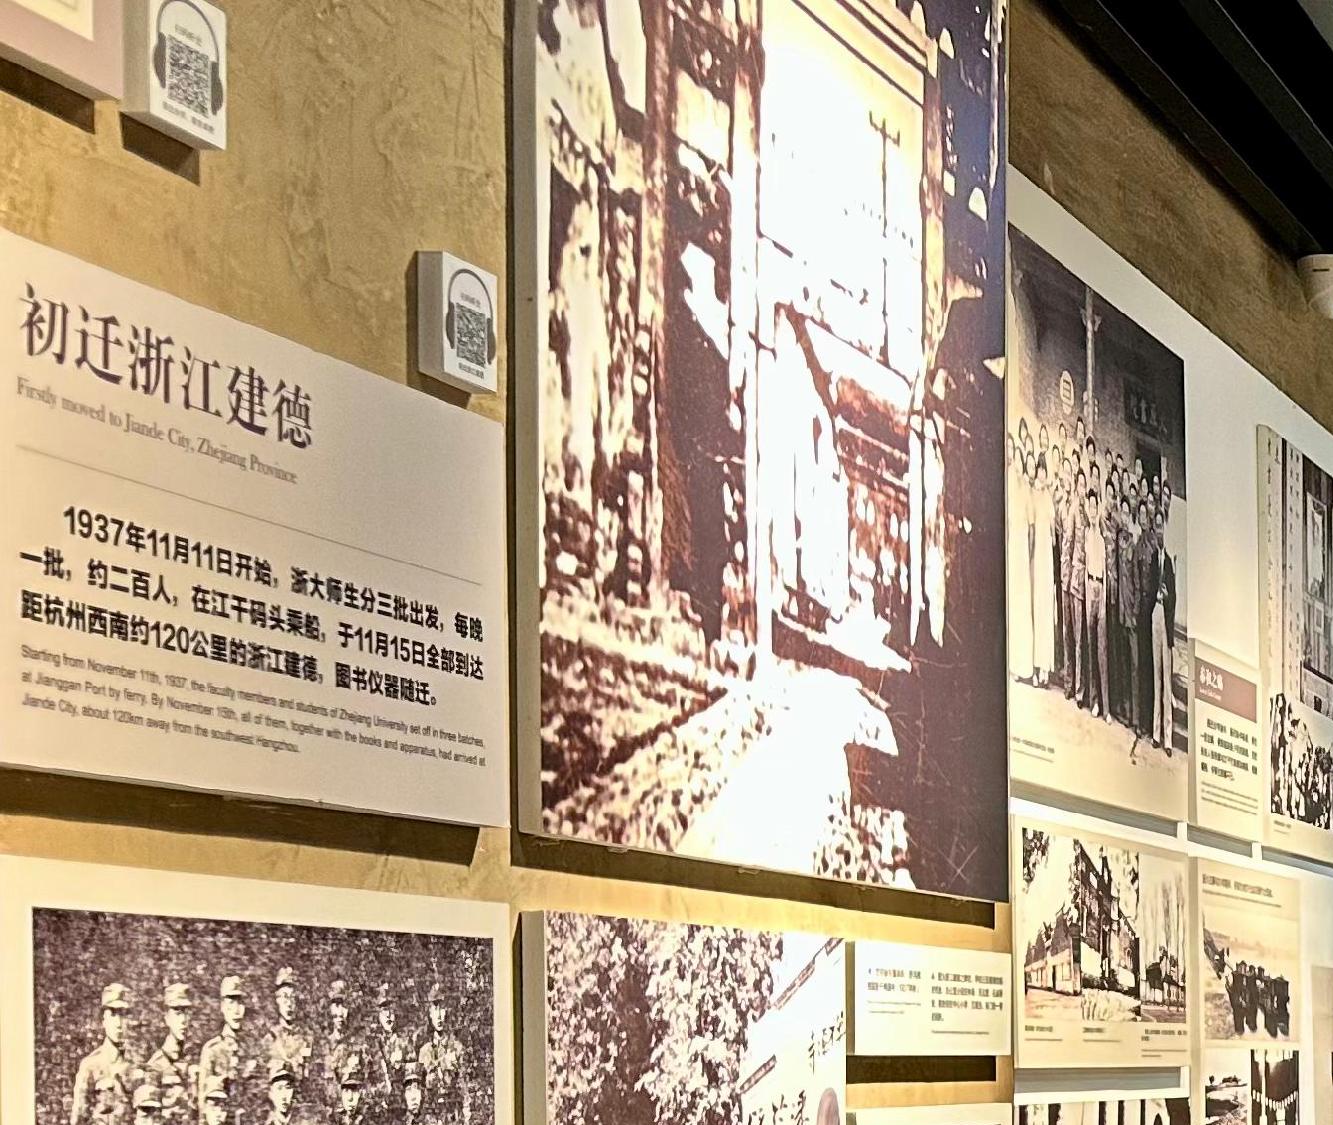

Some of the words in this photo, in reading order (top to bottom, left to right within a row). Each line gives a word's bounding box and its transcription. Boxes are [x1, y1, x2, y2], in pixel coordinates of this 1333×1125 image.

[17, 375, 57, 410] Firstly
[61, 395, 106, 424] moved
[109, 410, 122, 428] to
[123, 413, 165, 442] Jiande
[167, 428, 195, 453] City,
[197, 436, 248, 472] Zhejiang
[250, 453, 299, 485] Province
[20, 282, 314, 450] 初迁浙江建德
